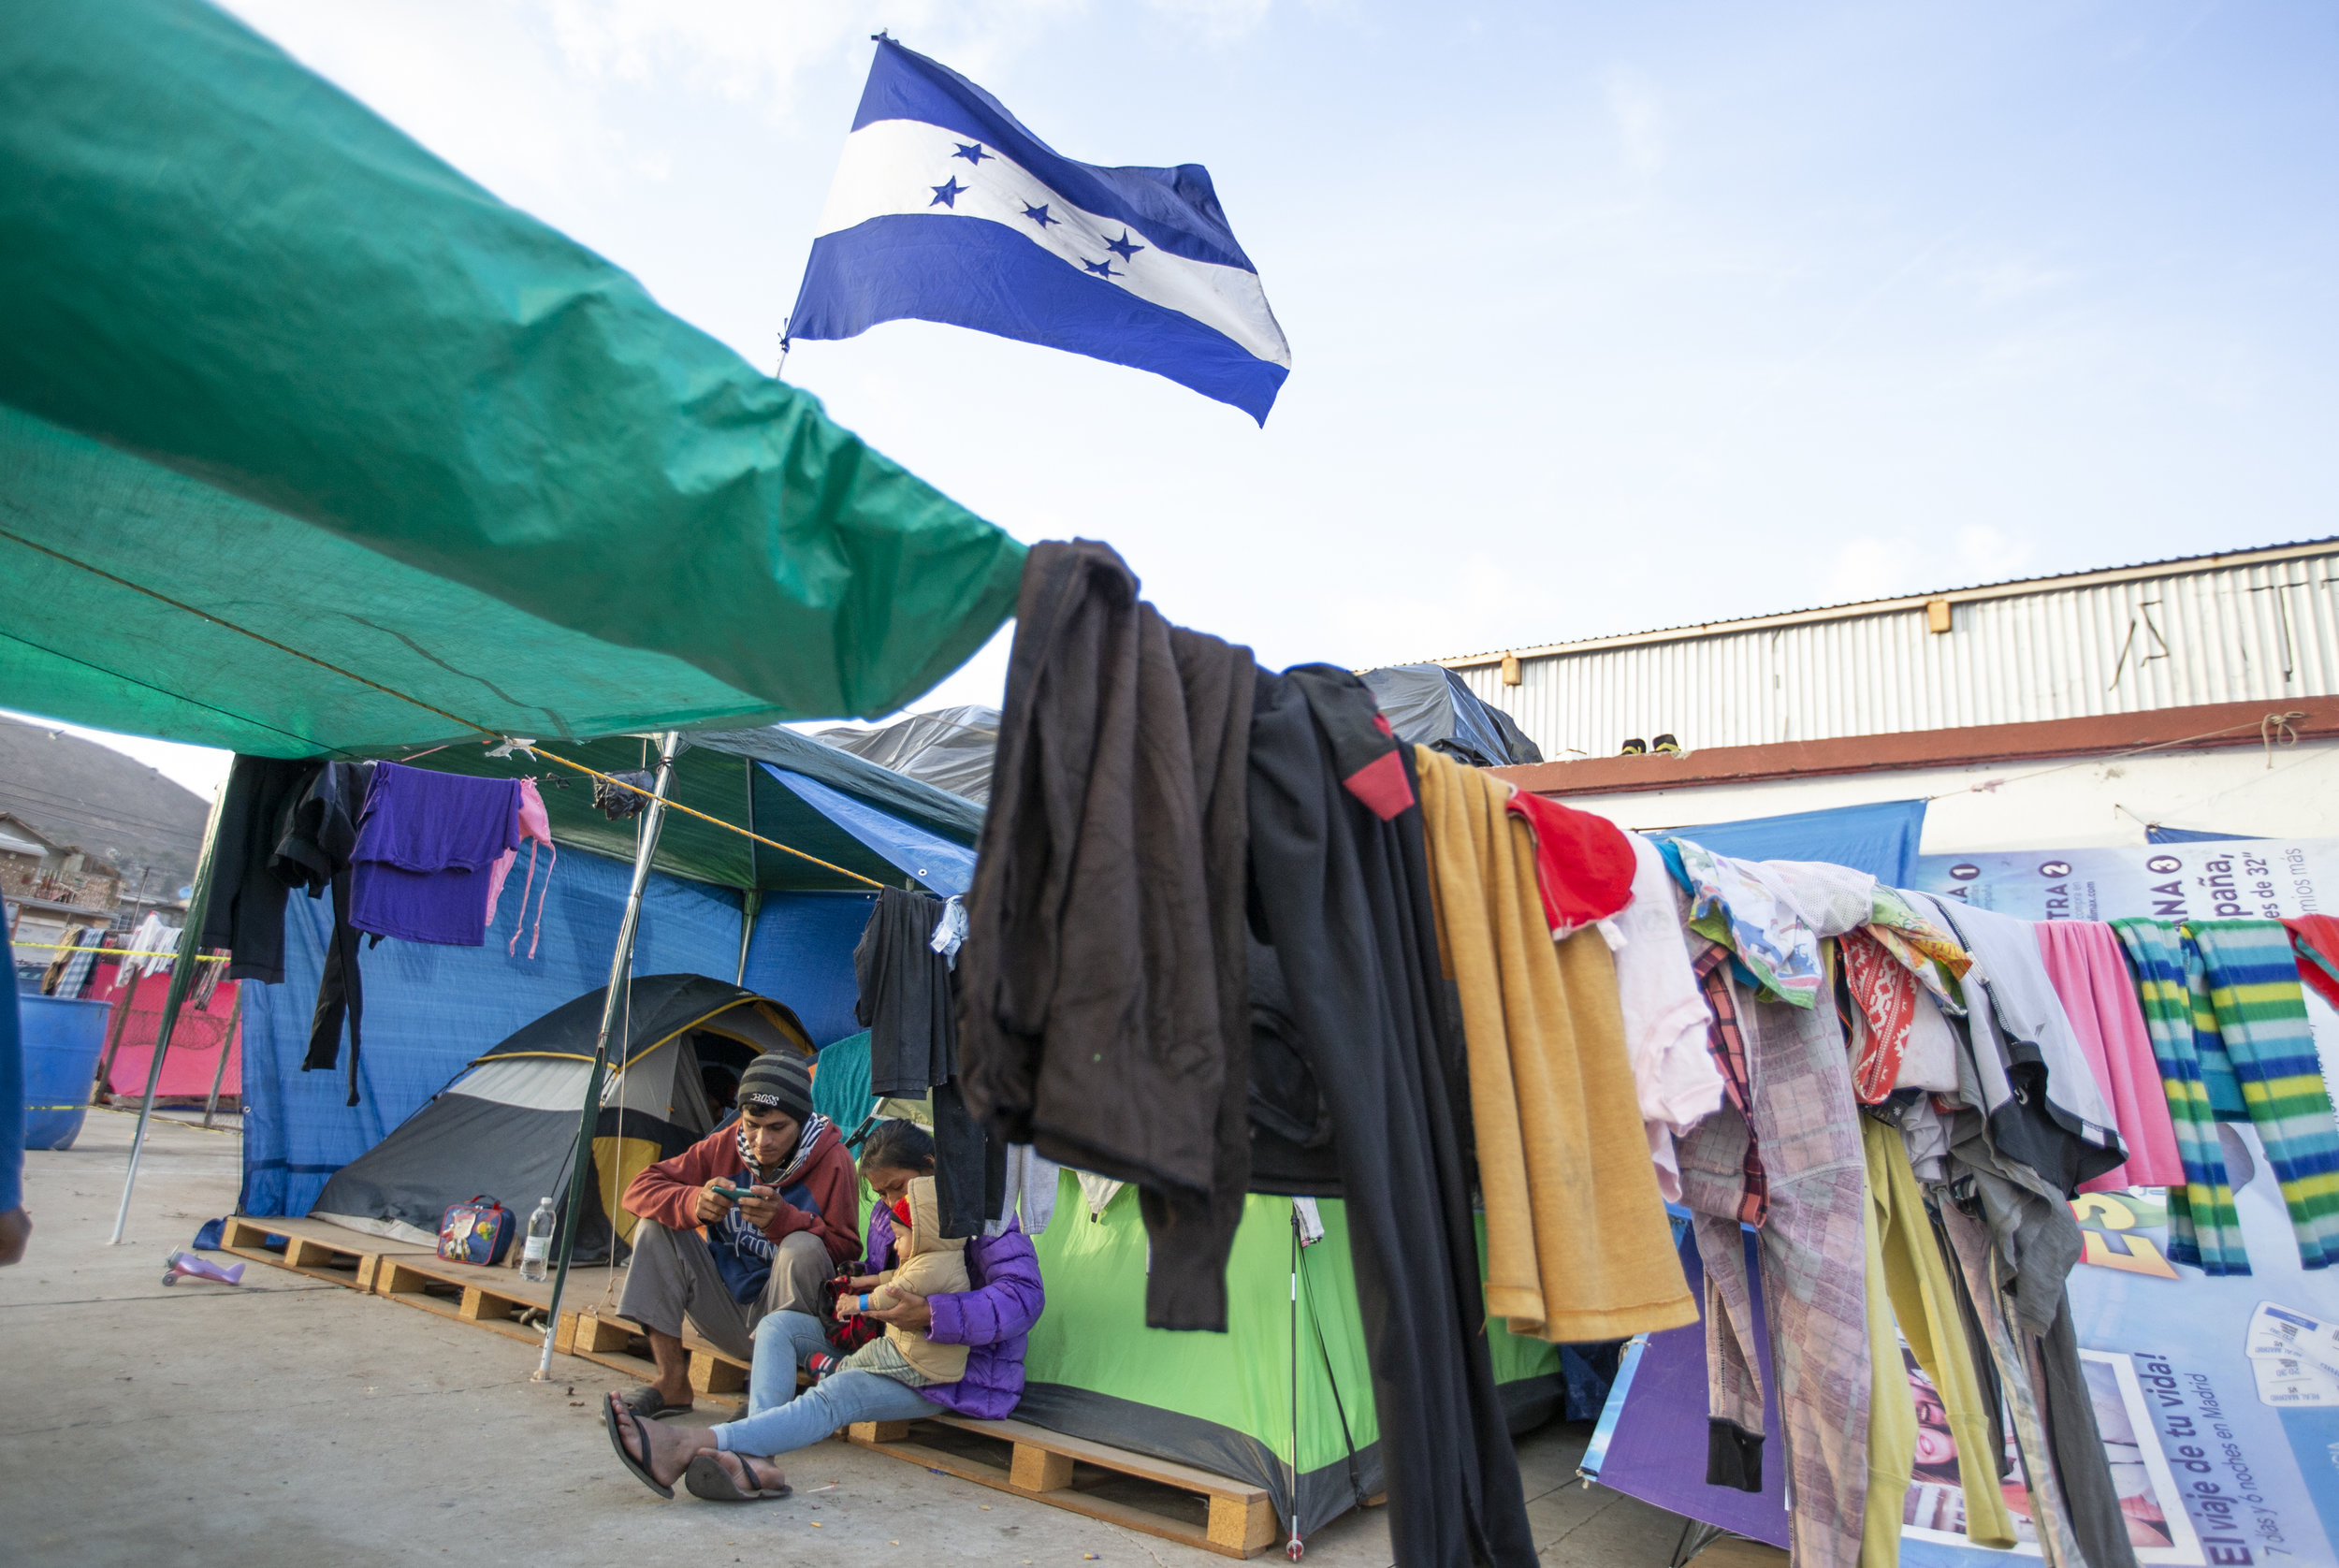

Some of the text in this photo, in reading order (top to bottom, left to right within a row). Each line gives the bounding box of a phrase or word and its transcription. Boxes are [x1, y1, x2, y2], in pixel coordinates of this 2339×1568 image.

[2044, 884, 2070, 920] TRA
[2196, 853, 2253, 918] paña,
[2250, 880, 2274, 898] de
[2280, 848, 2318, 914] mios más
[750, 1093, 779, 1107] BOSS
[2134, 1353, 2254, 1566] El viaje de tu vida!
[2184, 1372, 2291, 1557] 7 días y 6 noches en Madrid
